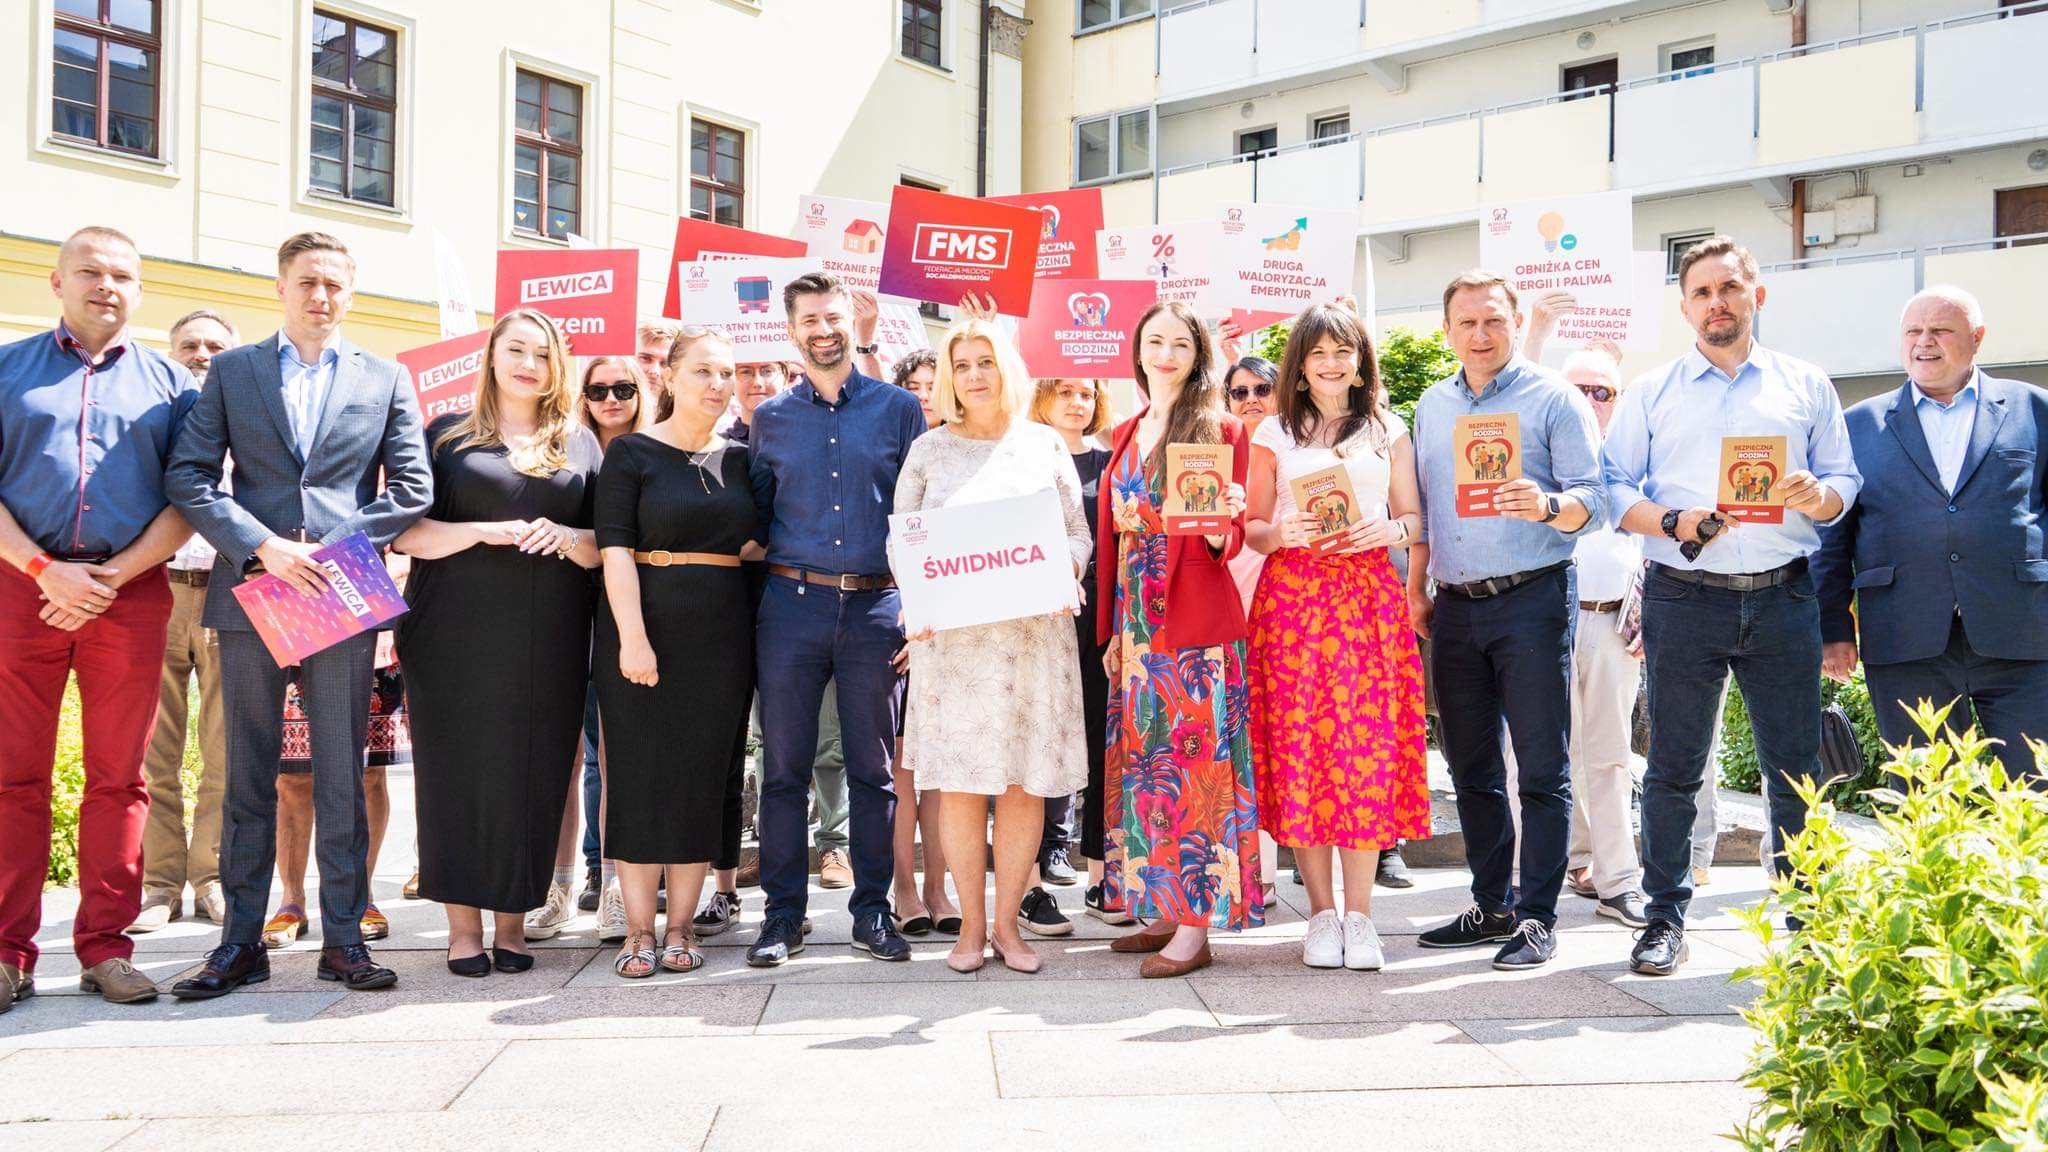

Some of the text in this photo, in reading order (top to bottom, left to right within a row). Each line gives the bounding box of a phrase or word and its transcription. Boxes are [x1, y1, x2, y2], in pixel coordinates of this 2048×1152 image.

[928, 231, 998, 261] FMS
[1039, 241, 1076, 254] ECZNA
[1037, 256, 1069, 267] DZINA
[1263, 259, 1304, 272] DRUGA
[1515, 259, 1601, 276] OBNIŻKA CEN
[1238, 270, 1327, 287] WALORYZACJA
[1563, 273, 1613, 287] PALIWA
[527, 274, 608, 299] LEWICA
[1250, 285, 1312, 300] EMERYTUR
[1599, 307, 1632, 317] PŁACE
[553, 316, 606, 335] zem
[754, 320, 788, 331] TRANS
[1559, 318, 1627, 329] W USŁUGACH
[760, 333, 789, 343] MŁOD
[1054, 330, 1125, 341] BEZPIECZNA
[1557, 330, 1627, 341] PUBLICZNYCH
[1063, 344, 1118, 354] RODZINA
[1468, 421, 1507, 429] BEZPIECZNA
[1473, 429, 1503, 437] RODZINA
[923, 544, 1046, 580] ŚWIDNICA
